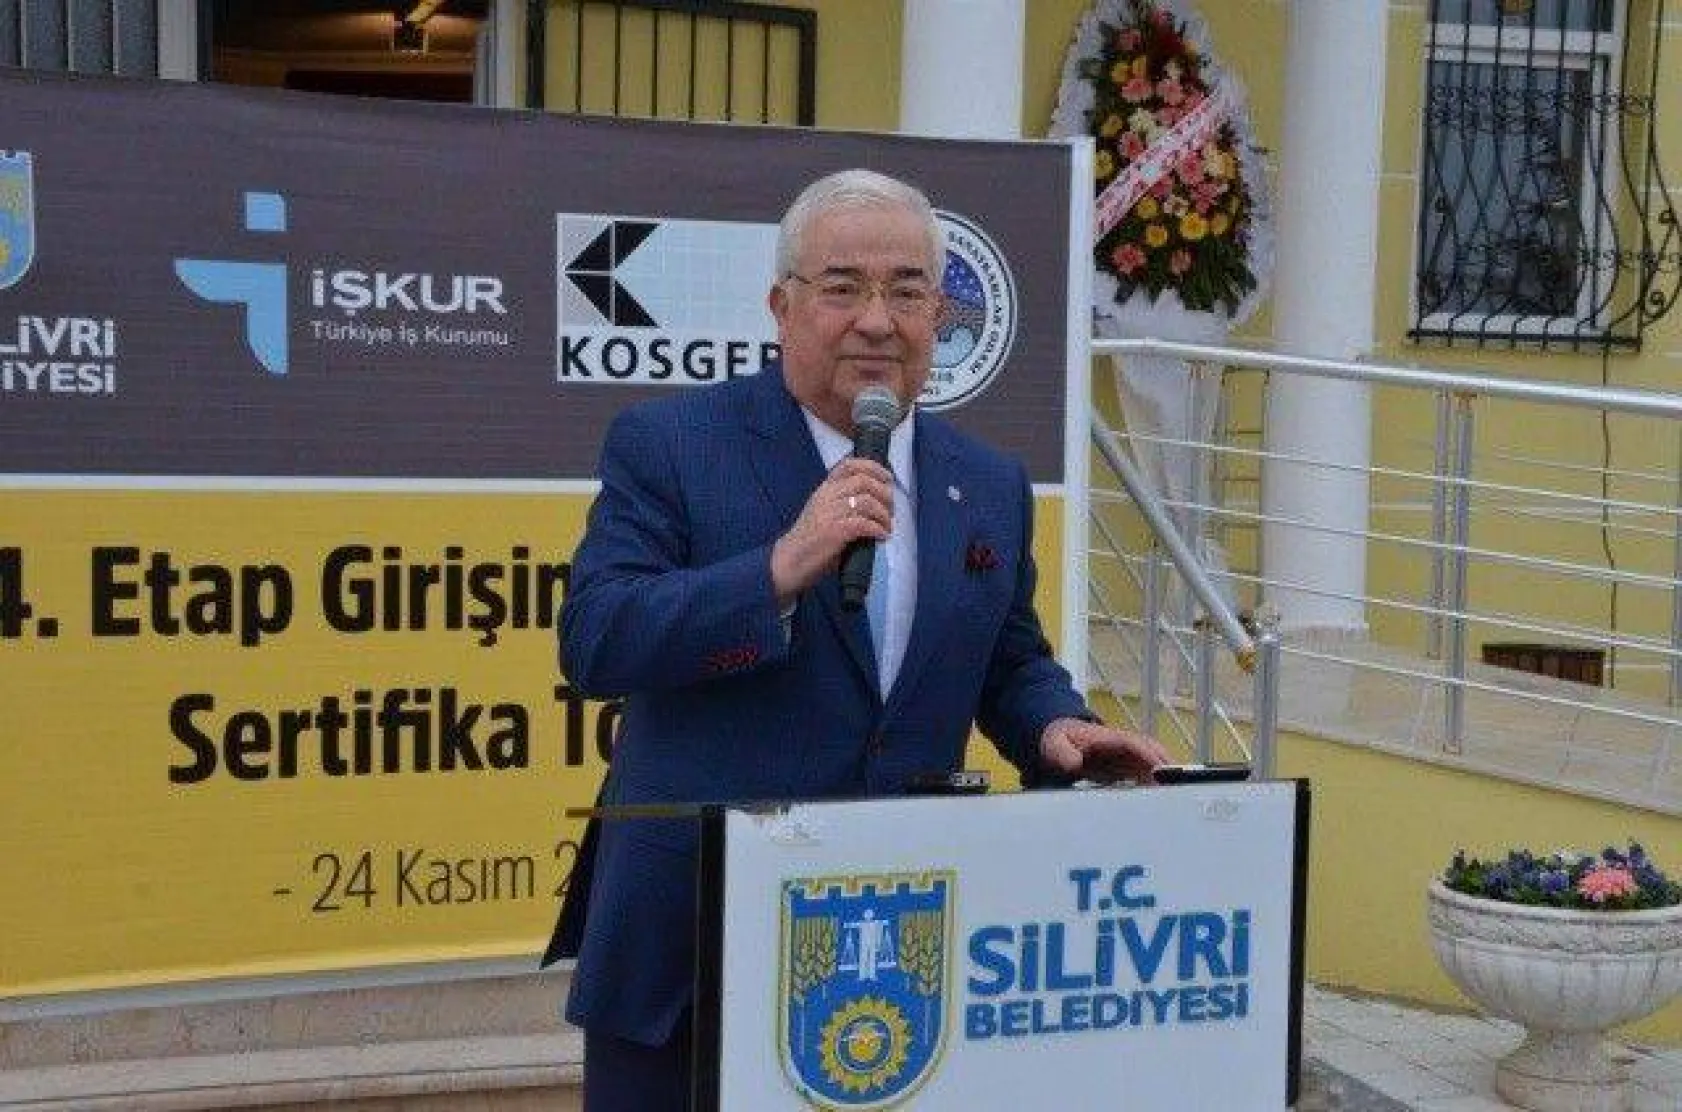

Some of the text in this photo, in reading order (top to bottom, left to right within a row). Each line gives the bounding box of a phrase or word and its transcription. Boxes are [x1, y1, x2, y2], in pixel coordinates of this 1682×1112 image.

[310, 320, 392, 345] Türkiye
[425, 324, 508, 346] Kurumu
[92, 547, 292, 646] Etap
[168, 689, 527, 783] Sertifika
[312, 851, 375, 913] 24
[397, 849, 533, 908] Kasım
